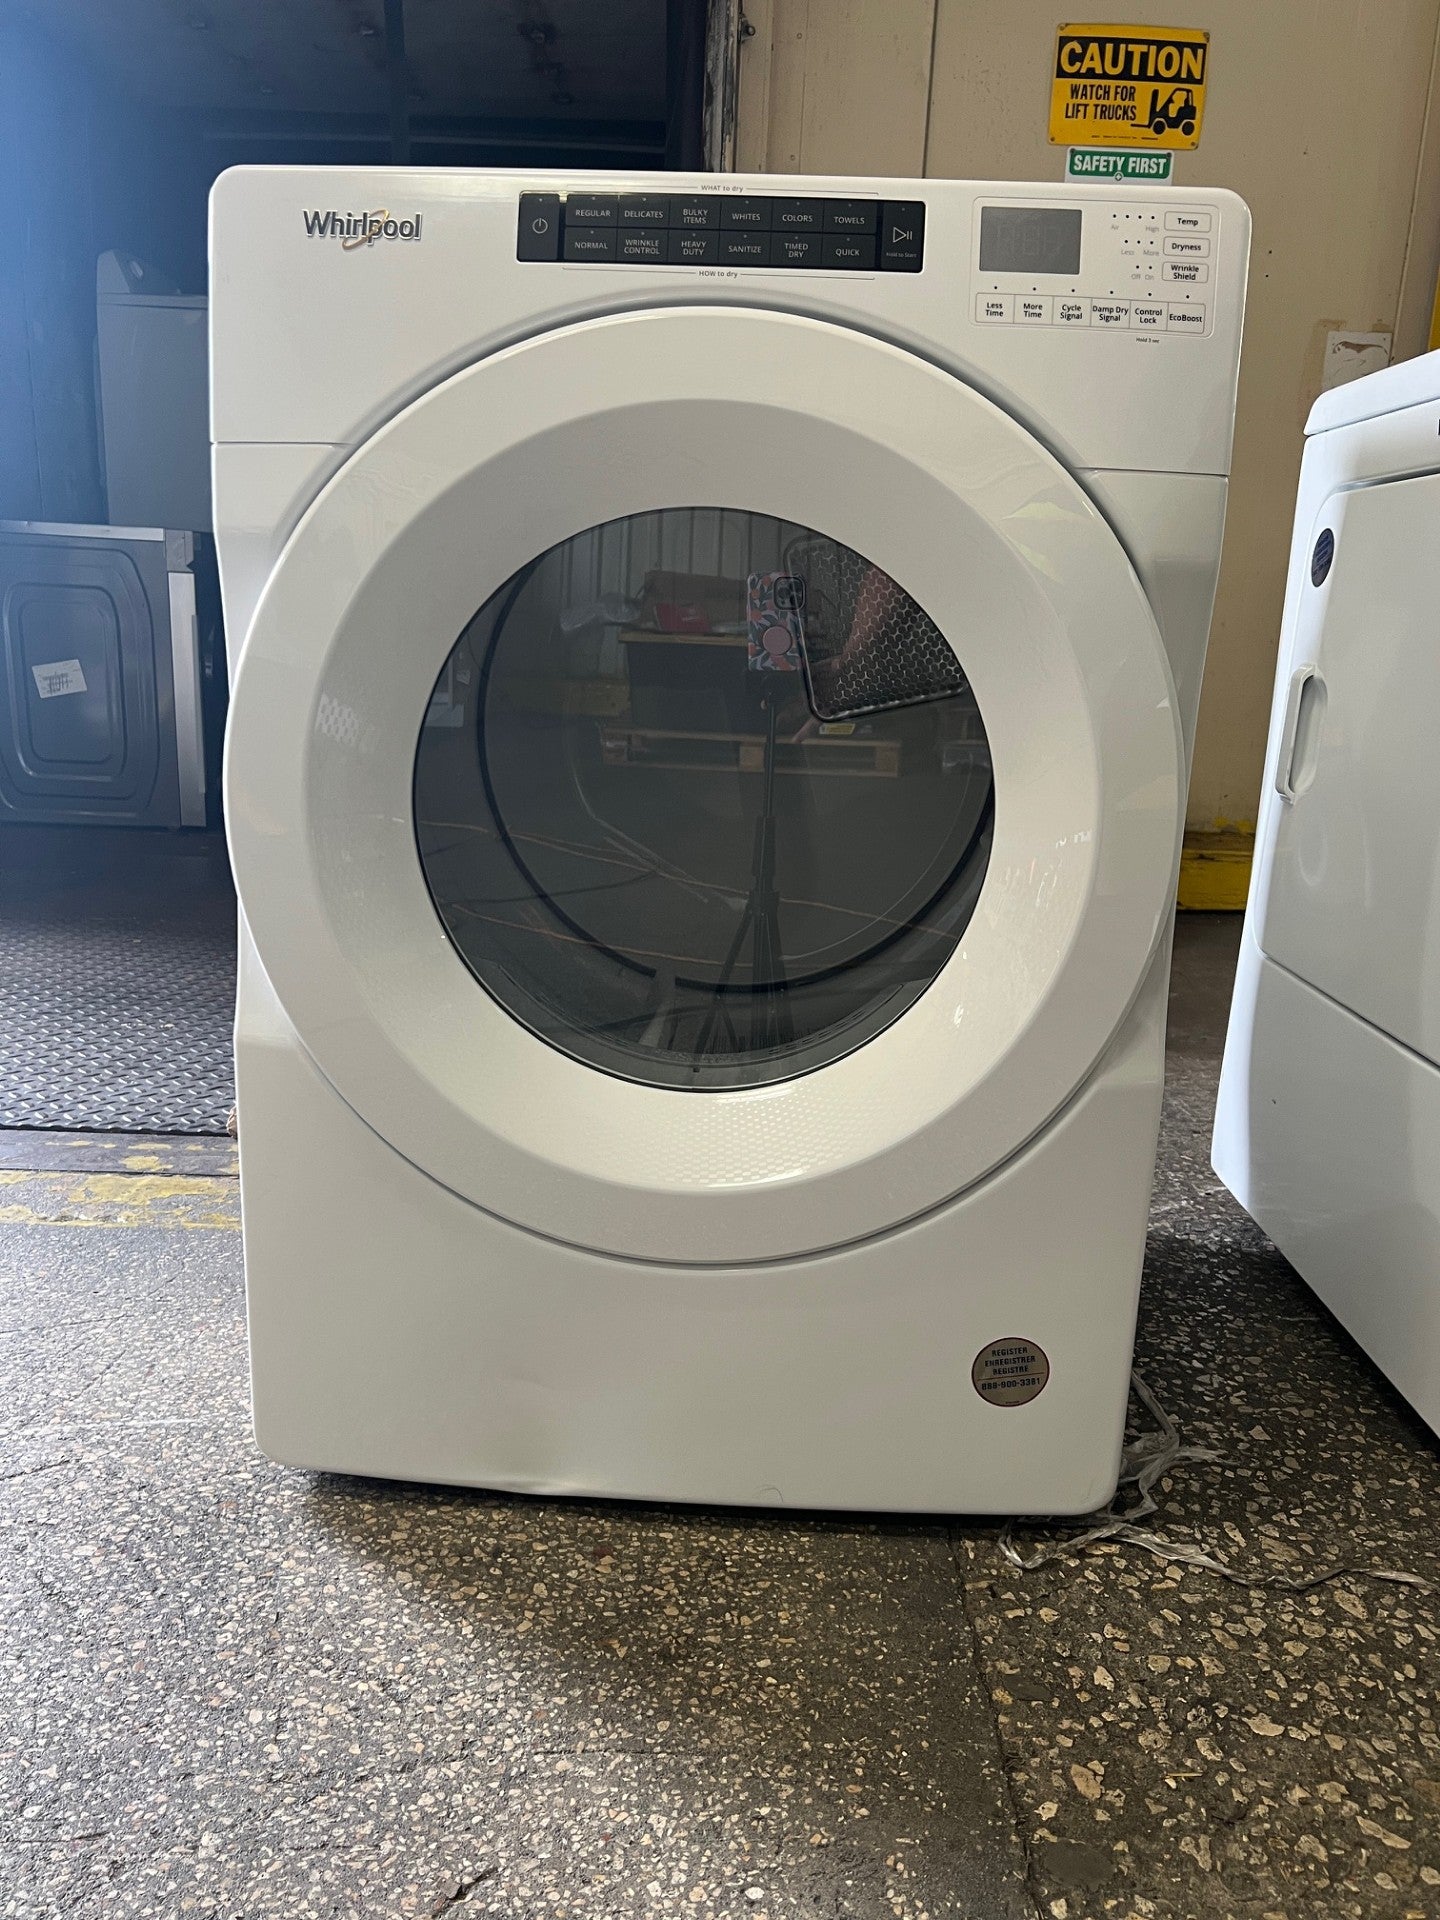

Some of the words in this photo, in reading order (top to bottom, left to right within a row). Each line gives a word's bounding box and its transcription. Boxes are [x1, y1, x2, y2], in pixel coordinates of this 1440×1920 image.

[1060, 40, 1204, 80] CAUTION
[1070, 83, 1111, 101] WATCH
[1113, 85, 1137, 102] FOR
[1065, 103, 1089, 120] LIFT
[1093, 104, 1137, 121] TRUCKS
[1073, 154, 1126, 172] SAFETY
[1127, 156, 1167, 174] FIRST
[731, 185, 743, 193] dry
[575, 209, 611, 217] REGULAR
[624, 210, 664, 219] DELICATES
[683, 208, 708, 217] BULKY
[732, 212, 761, 221] WHITES
[683, 216, 707, 225] ITEMS
[782, 214, 813, 223] COLORS
[834, 216, 865, 225] TOWELS
[1177, 217, 1199, 226] Temp
[302, 208, 422, 248] Whirlpool
[1145, 225, 1160, 233] High
[574, 241, 608, 250] NORMAL
[625, 239, 659, 247] WRINKLE
[681, 240, 707, 249] HEAVY
[784, 242, 809, 250] TIMED
[1171, 242, 1201, 252] Dryness
[624, 246, 660, 255] CONTROL
[683, 247, 704, 256] DUTY
[728, 245, 762, 253] SANITIZE
[835, 248, 860, 257] QUICK
[788, 250, 804, 258] DRY
[1171, 264, 1199, 272] Wrinkle
[726, 270, 738, 278] dry
[1173, 272, 1197, 281] Shield
[1023, 302, 1043, 311] More
[1061, 303, 1082, 313] Cycle
[1092, 305, 1115, 315] Damp
[1115, 306, 1129, 315] Dry
[985, 309, 1004, 317] Time
[1023, 310, 1042, 318] Time
[1060, 311, 1083, 321] Signal
[1134, 307, 1162, 316] Control
[1099, 313, 1121, 323] Signal
[1139, 316, 1157, 324] Lock
[1169, 313, 1203, 323] EcoBoost
[991, 1346, 1028, 1358] REGISTER
[984, 1355, 1036, 1368] ENREGISTRER
